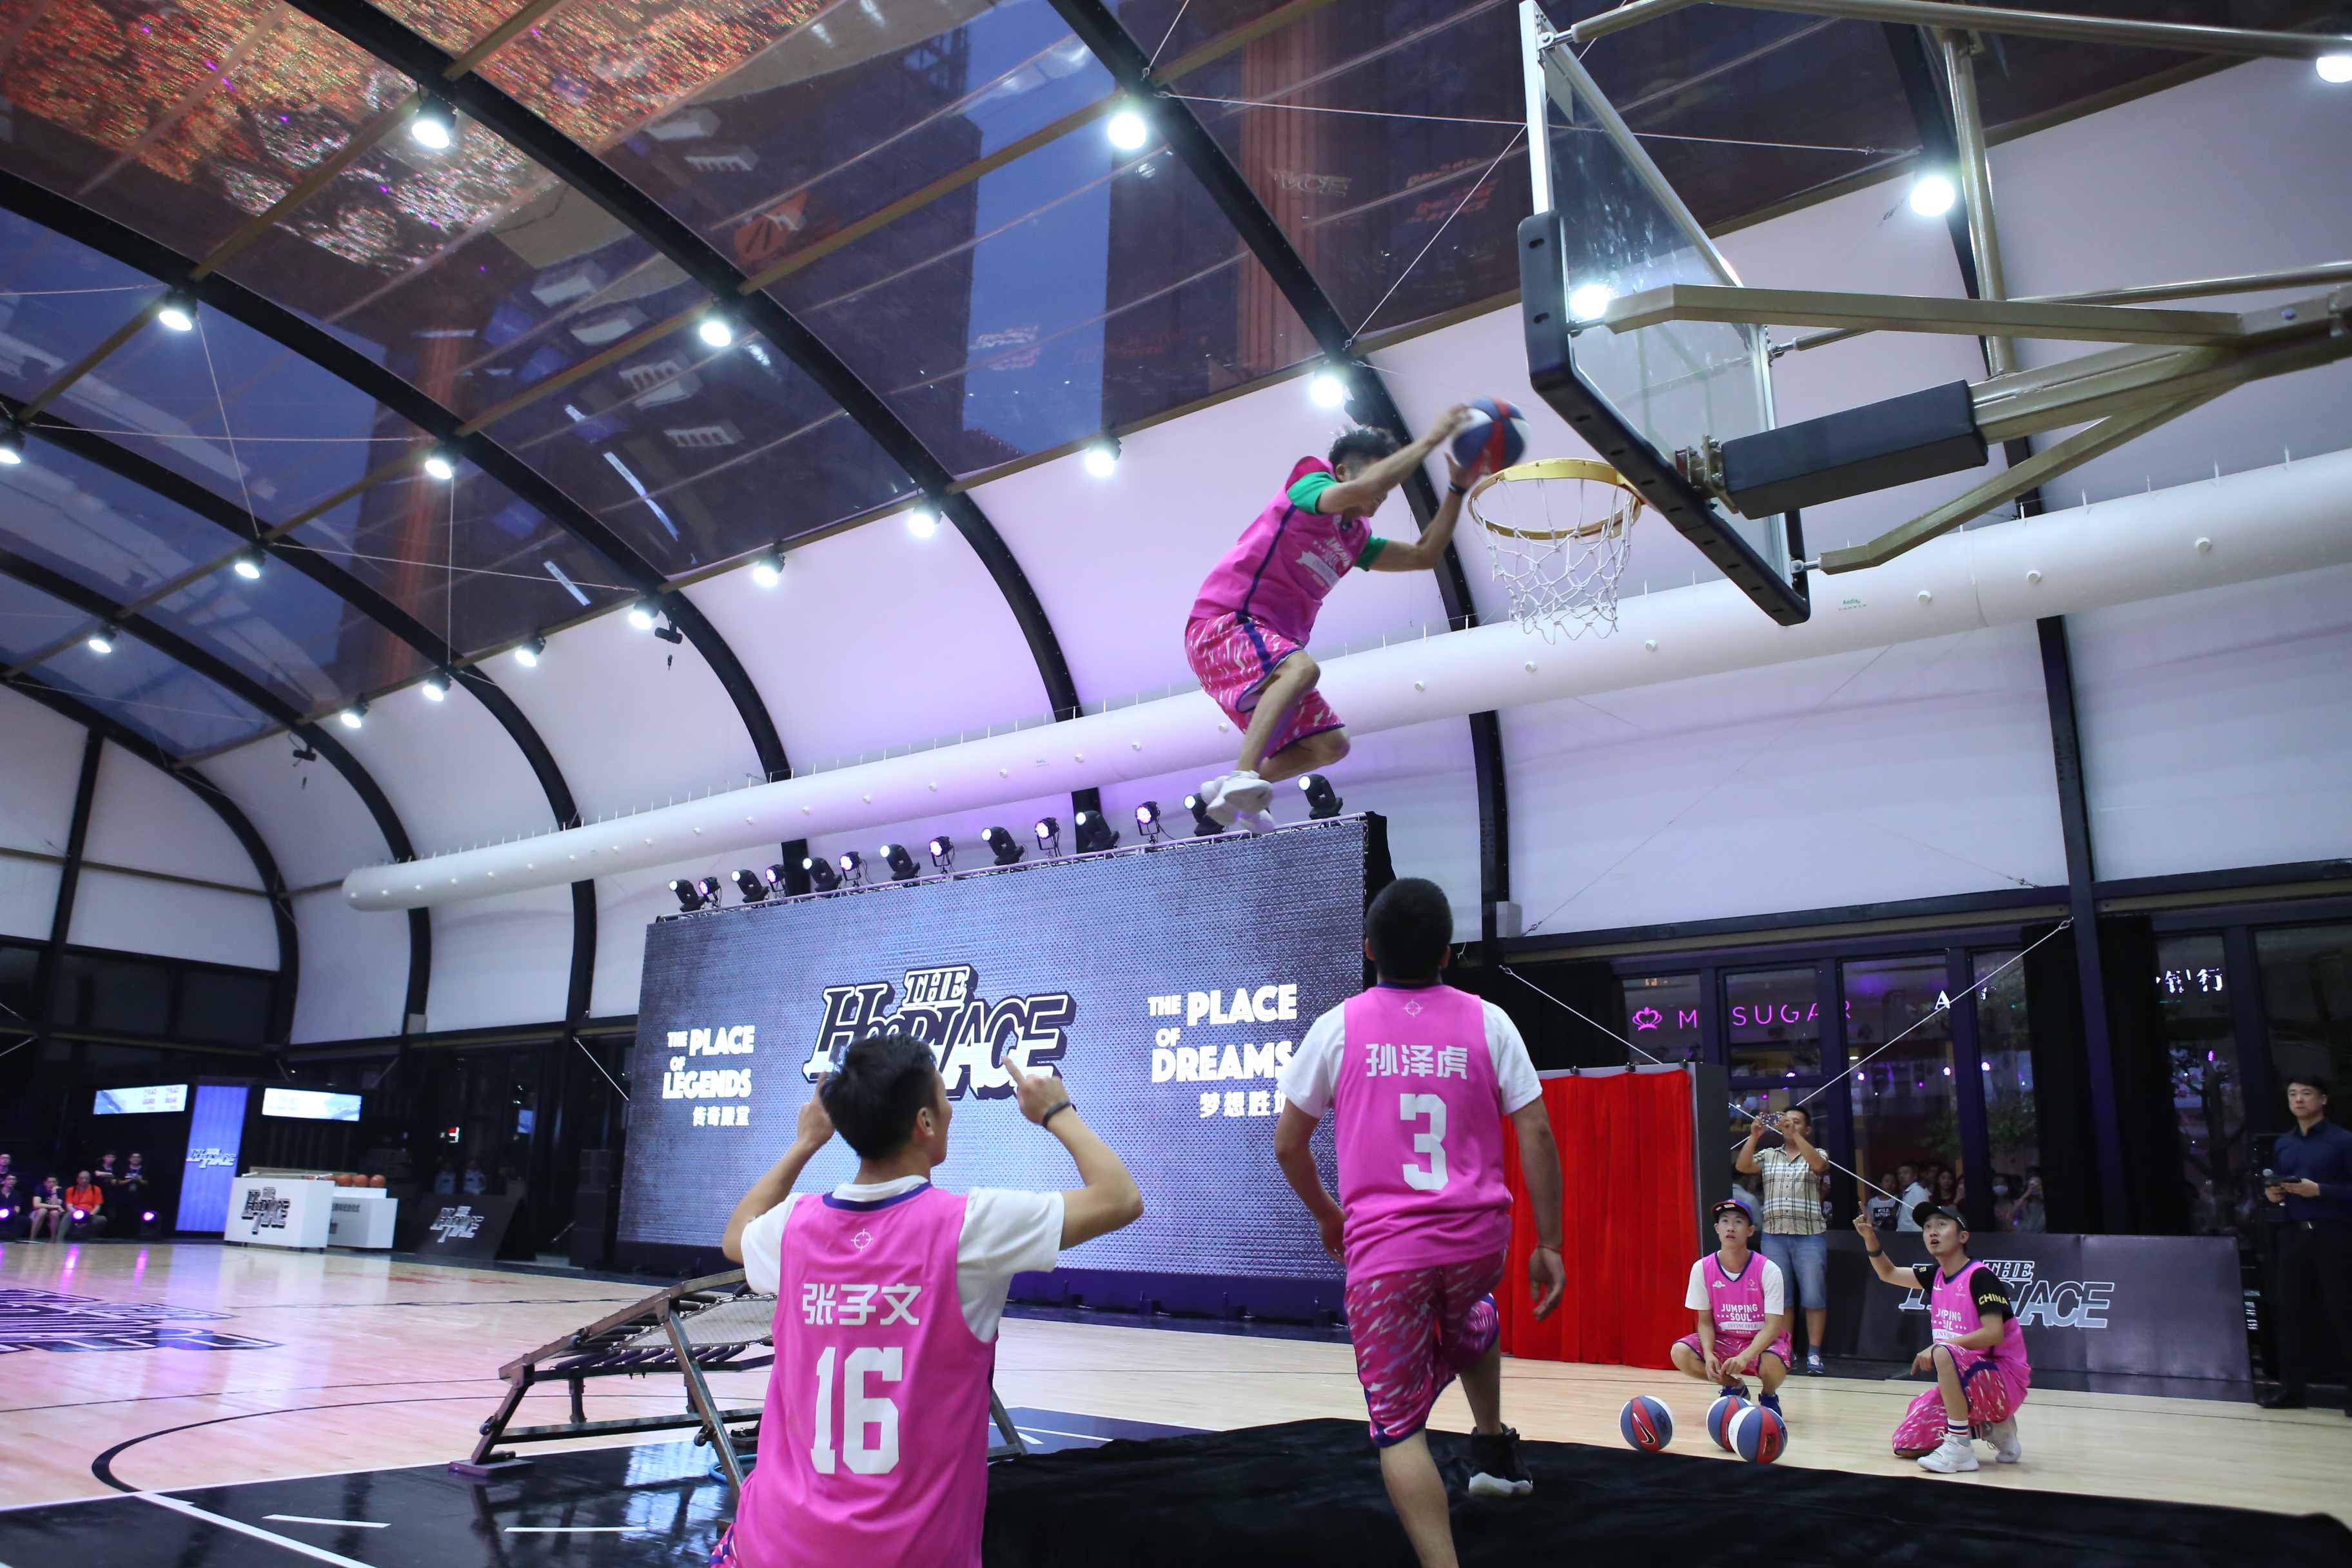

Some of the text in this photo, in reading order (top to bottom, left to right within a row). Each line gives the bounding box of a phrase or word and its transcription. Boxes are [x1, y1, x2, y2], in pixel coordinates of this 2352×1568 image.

[902, 966, 972, 1006] THE
[1148, 984, 1297, 1026] THE PLACE
[667, 1025, 755, 1056] THE PLACE
[1155, 1027, 1181, 1047] OF
[670, 1056, 686, 1072] OF
[1152, 1041, 1293, 1083] DREAMS
[1366, 1043, 1468, 1080] 孙泽虎
[662, 1068, 752, 1099] LEGENDS
[1400, 1093, 1449, 1191] 3
[1983, 1260, 2035, 1281] THE
[802, 1283, 922, 1326] 张子文
[1721, 1303, 1758, 1313] JUMPING
[1935, 1308, 1962, 1322] JPING
[1978, 1293, 2009, 1306] CHINA
[1730, 1312, 1752, 1322] SOUL
[810, 1346, 903, 1475] 16
